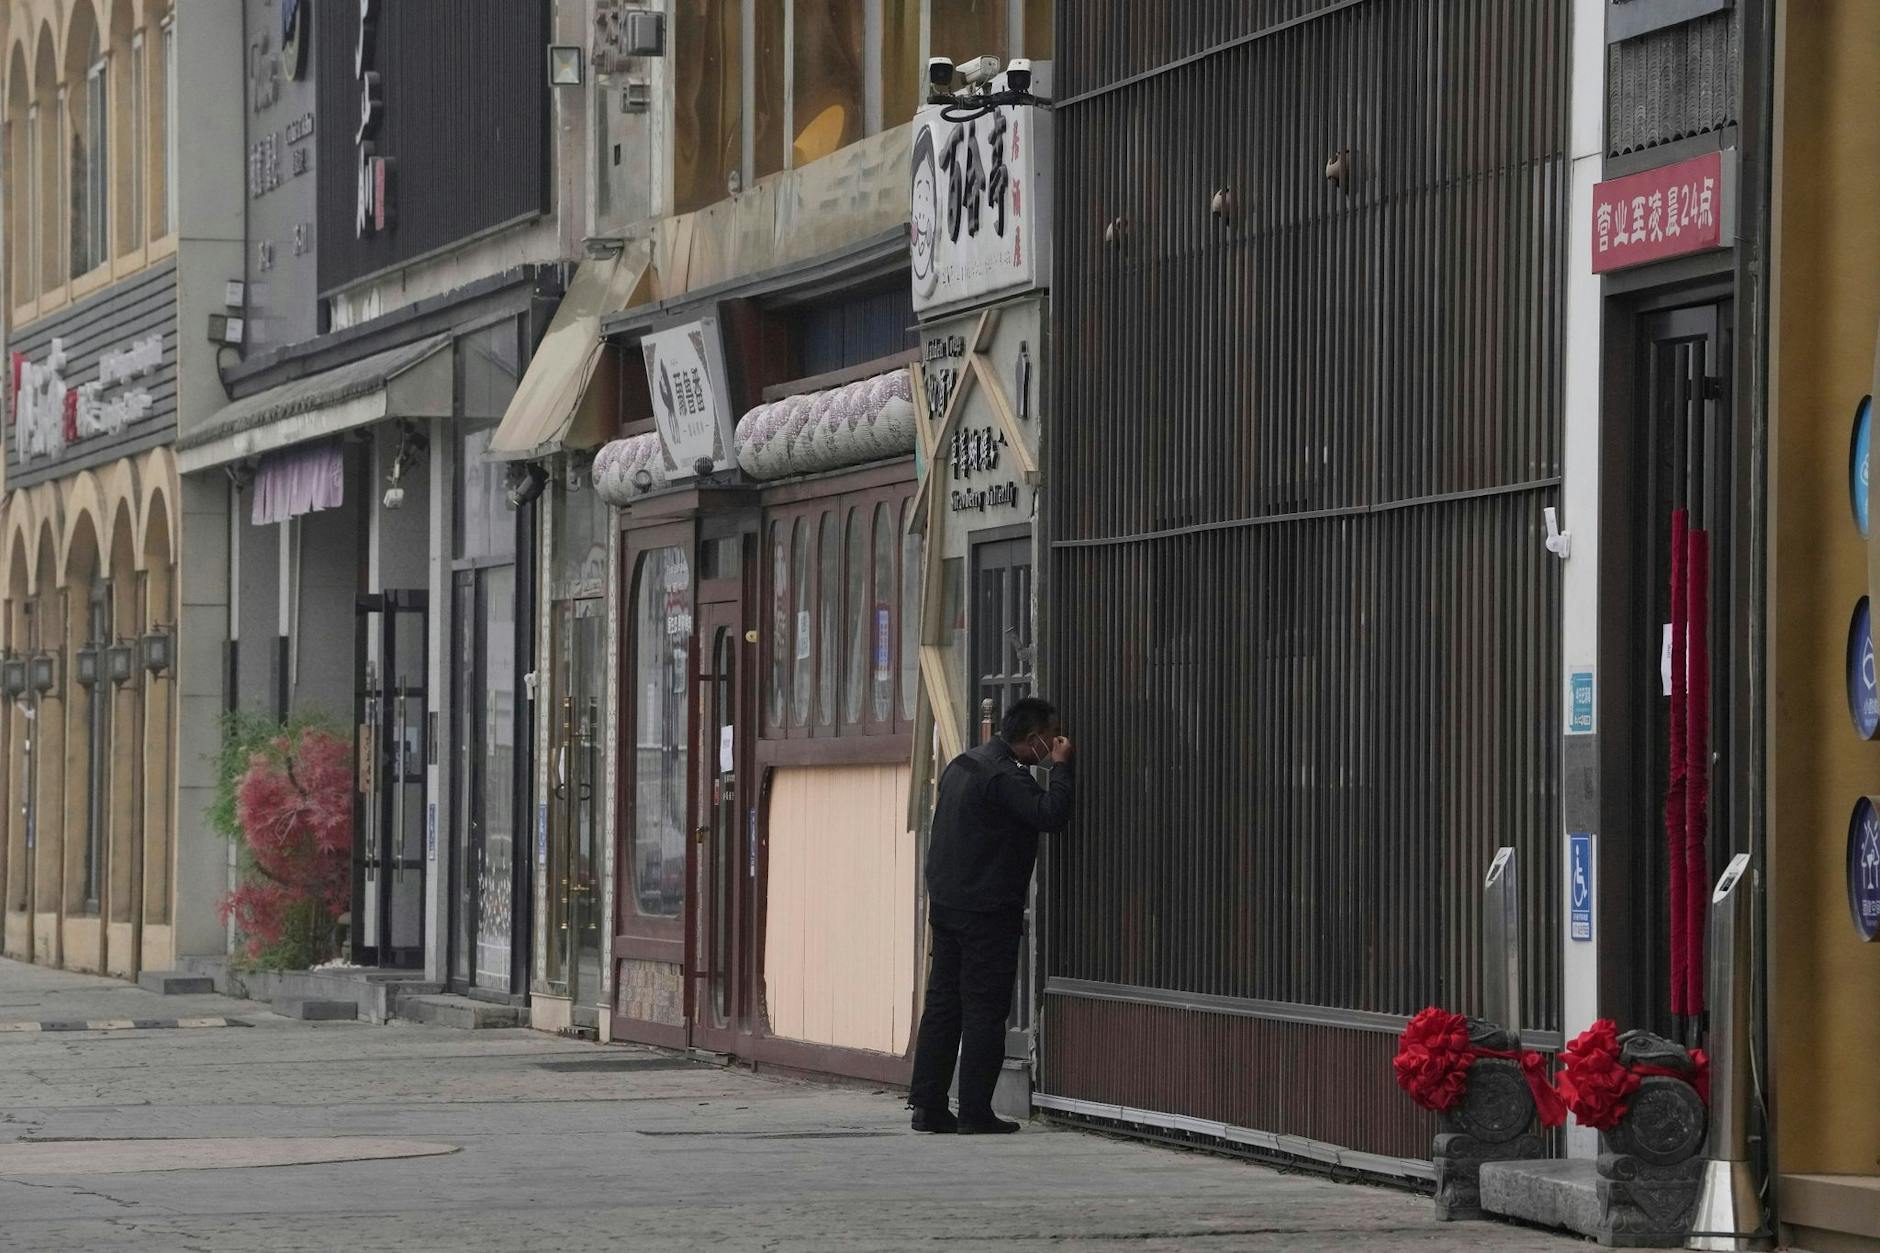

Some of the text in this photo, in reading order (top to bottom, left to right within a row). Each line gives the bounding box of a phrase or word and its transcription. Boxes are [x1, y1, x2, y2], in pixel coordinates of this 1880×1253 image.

[1597, 176, 1714, 252] 营业至凌晨24点
